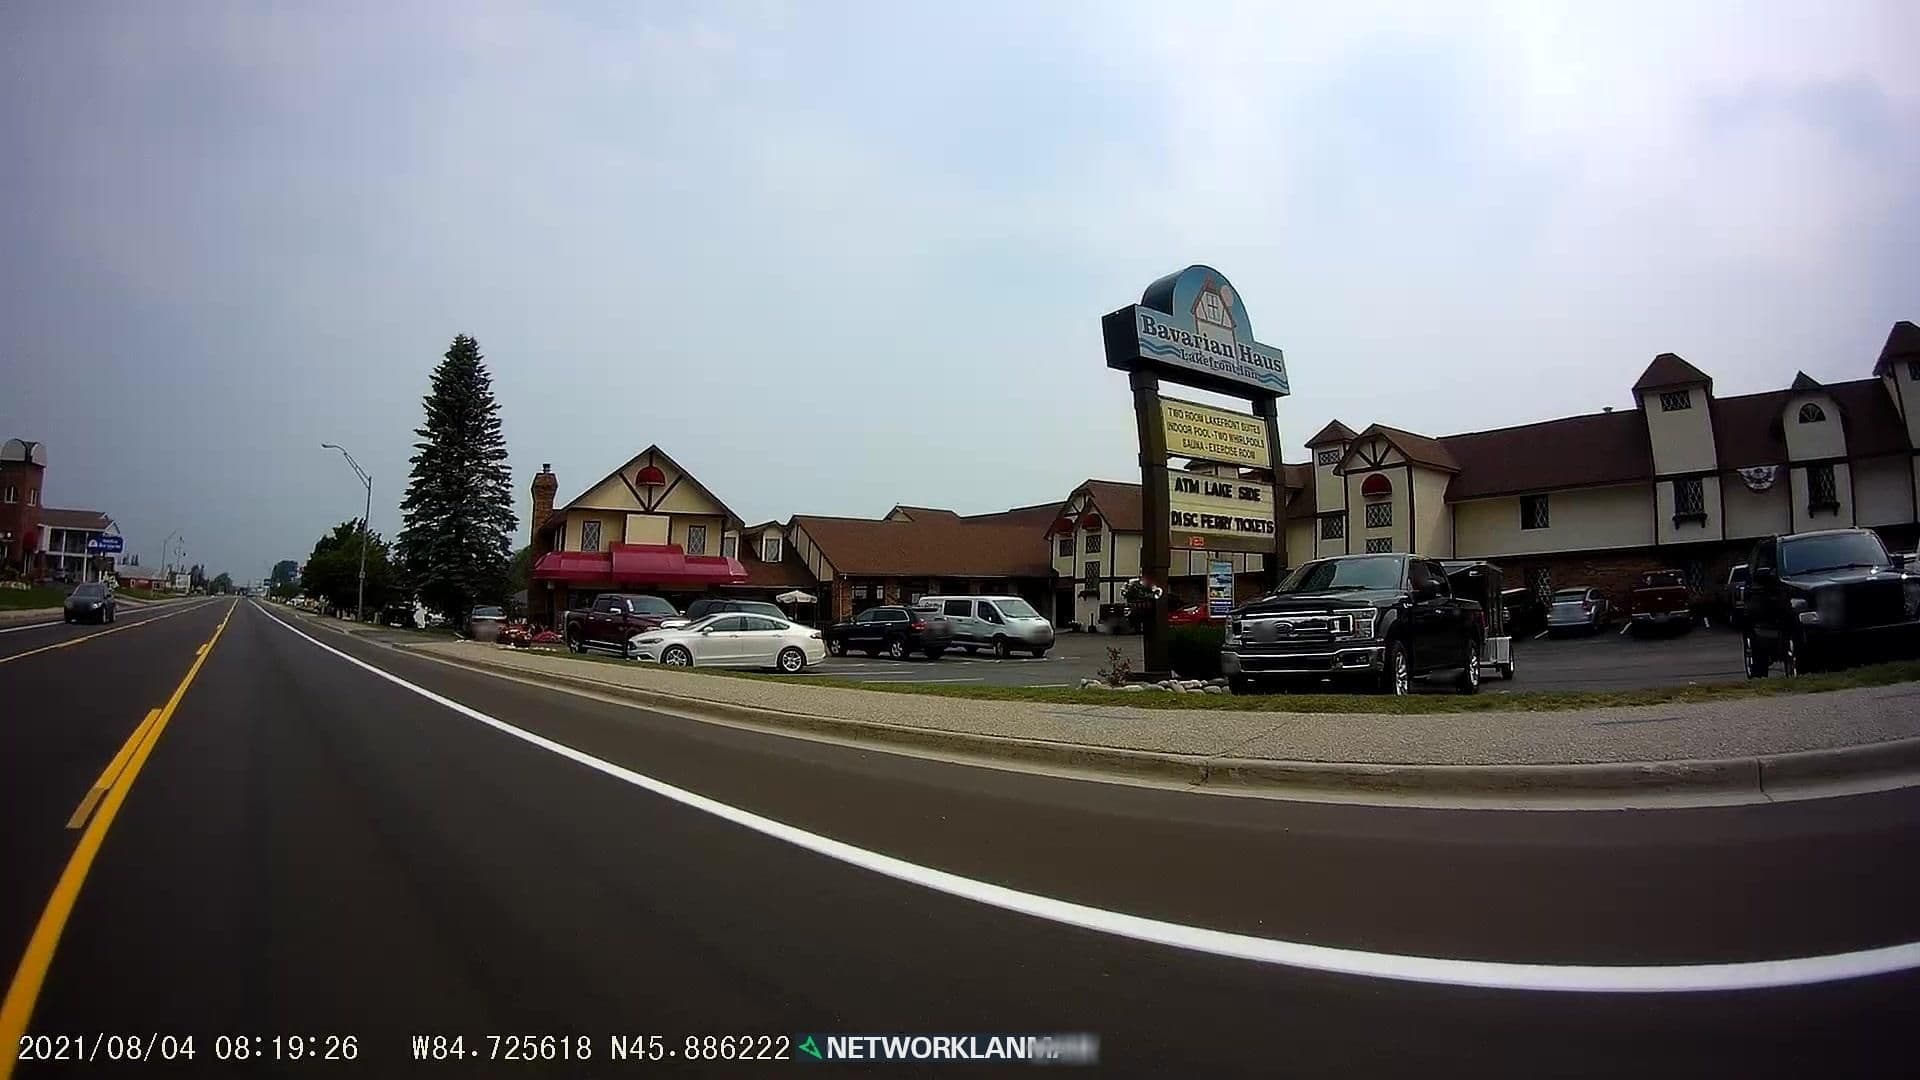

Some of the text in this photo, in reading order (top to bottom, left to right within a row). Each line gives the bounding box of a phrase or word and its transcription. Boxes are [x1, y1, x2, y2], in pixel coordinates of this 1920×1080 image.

[1141, 314, 1283, 373] Bavarian Haus
[1180, 348, 1240, 376] Lakefront
[1174, 477, 1200, 494] ATM
[1204, 481, 1233, 499] LAKE
[1171, 510, 1275, 534] DISC FERRY TICKETS
